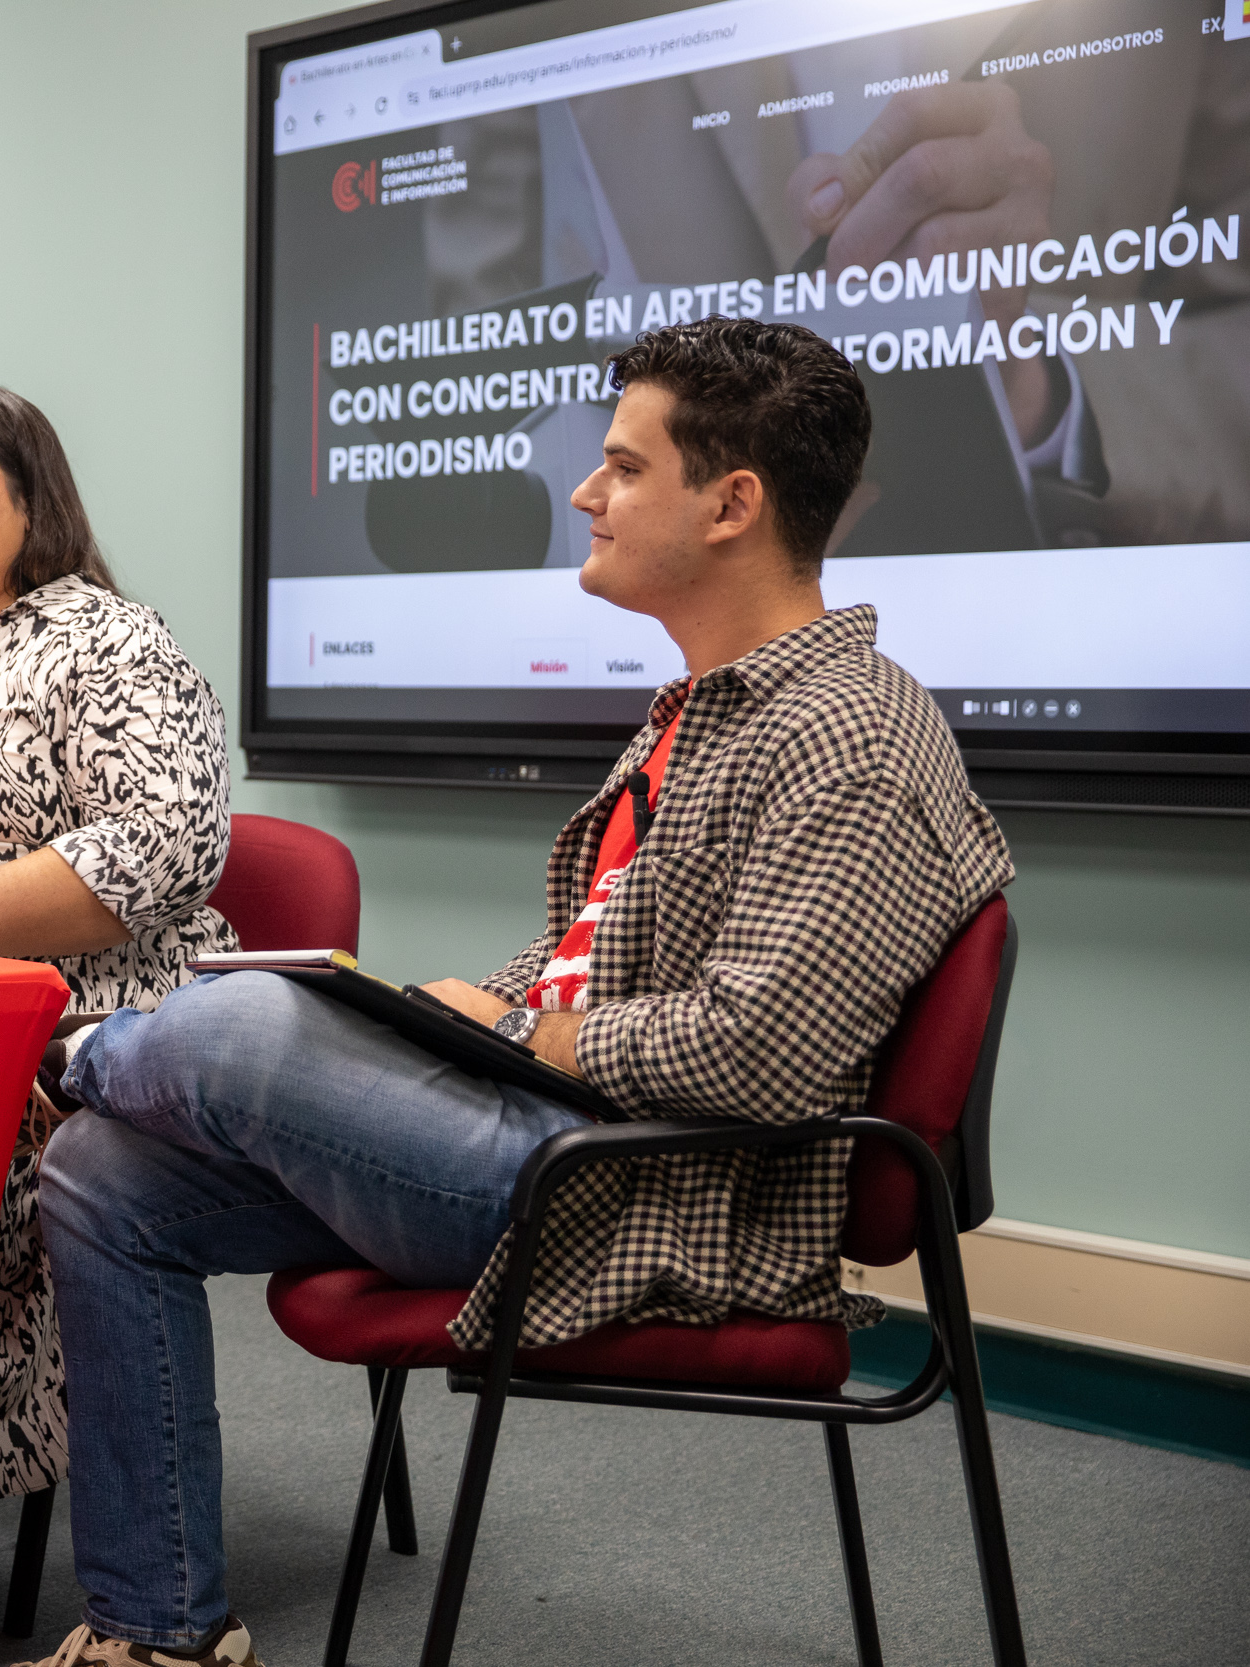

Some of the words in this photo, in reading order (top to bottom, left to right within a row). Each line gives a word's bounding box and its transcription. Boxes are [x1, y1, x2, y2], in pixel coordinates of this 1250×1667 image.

[692, 110, 731, 131] INICIO
[757, 91, 834, 118] ADMISIONES
[864, 69, 949, 98] PROGRAMAS
[981, 52, 1040, 77] ESTUDIA
[1043, 44, 1077, 64] CON
[1080, 27, 1164, 58] NOSOTROS
[382, 149, 436, 171] FACULTAD
[438, 145, 454, 161] DE
[382, 159, 467, 188] COMUNICACIÓN
[381, 191, 389, 205] E
[391, 176, 467, 203] INFORMACIÓN
[330, 302, 578, 368] BACHILLERATO
[585, 295, 632, 338] EN
[640, 277, 763, 331] ARTES
[774, 268, 826, 315] EN
[837, 206, 1239, 308] COMUNICACIÓN
[329, 383, 401, 425] CON
[1149, 298, 1184, 346] Y
[329, 431, 533, 484] PERIODISMO
[323, 640, 374, 655] ENLACES
[530, 659, 568, 673] Misión
[606, 659, 644, 673] Visión
